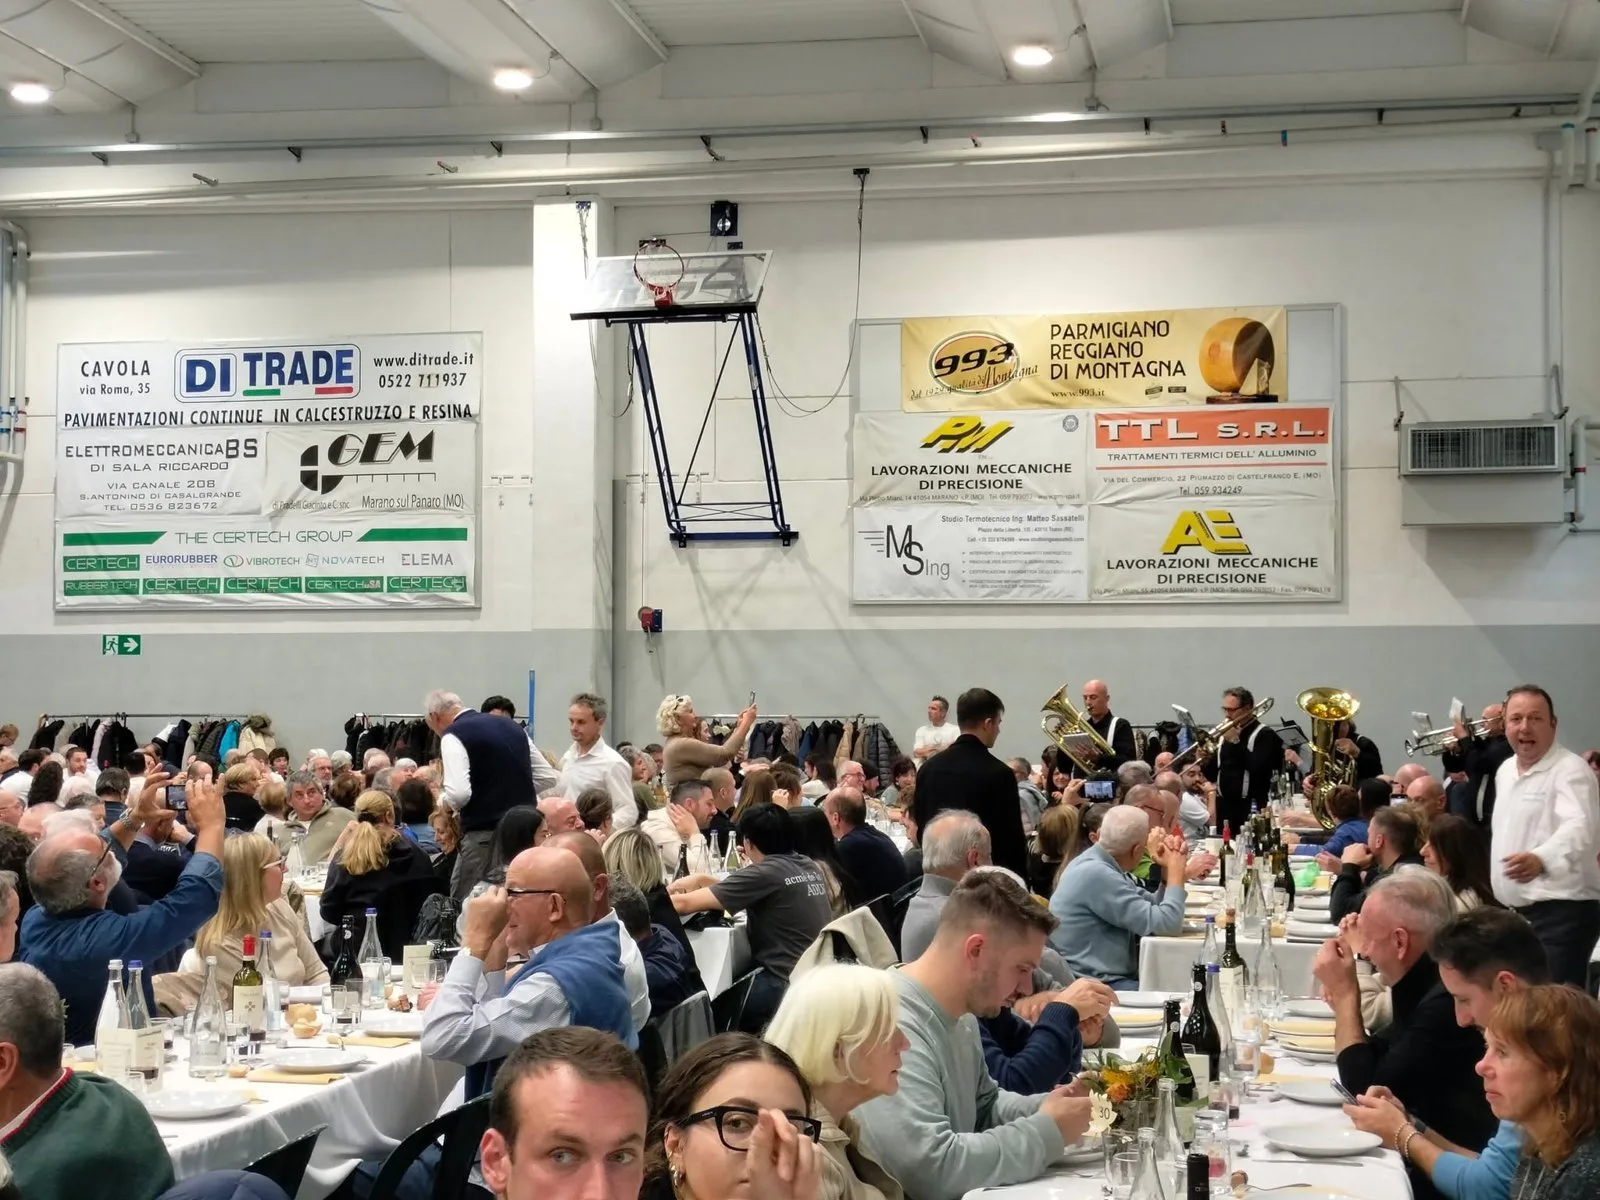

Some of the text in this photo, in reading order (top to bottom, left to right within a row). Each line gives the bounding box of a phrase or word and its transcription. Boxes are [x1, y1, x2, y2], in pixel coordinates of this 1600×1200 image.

[1051, 320, 1169, 340] PARMIGIANO
[1051, 341, 1144, 360] REGGIANO
[373, 351, 474, 367] www.ditrade.it
[934, 342, 1014, 378] 993
[81, 360, 150, 377] CAVOLA
[186, 350, 353, 393] DI TRADE
[1051, 360, 1186, 380] DI MONTAGNA
[379, 372, 466, 388] 0522 711937
[80, 382, 150, 396] via Roma, 35
[1051, 387, 1105, 398] www.993.it
[64, 403, 472, 427] PAVIMENTAZIONI CONTINUE IN CALCESTRUZZO E RESINA
[1099, 418, 1199, 442] TTL
[1217, 420, 1326, 439] S.R.L.
[328, 429, 435, 466] GEM
[1108, 449, 1317, 461] TRATTAMENTI TERMICI DELL' ALLUMINIO
[90, 461, 229, 472] DI SALA RICCARDO
[871, 463, 1072, 476] LAVORAZIONI MECCANICHE
[107, 480, 216, 490] VIA CANALE 208
[919, 479, 1023, 490] DI PRECISIONE
[164, 491, 242, 499] CASALGRANDE
[362, 493, 464, 509] Marano sul Panaro (MO)
[130, 503, 163, 511] 0536
[168, 502, 218, 510] 823672
[942, 515, 964, 523] Studio
[965, 514, 1011, 523] Termotecnico
[1026, 514, 1050, 522] Matteo
[175, 530, 353, 544] THE CERTECH GROUP
[1160, 510, 1252, 555] AE
[66, 557, 138, 570] CERTECH
[146, 554, 218, 564] EURORUBBER
[246, 556, 300, 566] VIBROTECH
[322, 556, 385, 565] NOVATECH
[401, 553, 454, 566] ELEMA
[1107, 557, 1318, 570] LAVORAZIONI MECCANICHE
[926, 559, 950, 580] Ing
[145, 578, 218, 590] CERTECH
[226, 577, 300, 590] CERTECH
[307, 580, 364, 590] CERTECH
[1158, 573, 1266, 584] DI PRECISIONE
[1099, 1107, 1110, 1120] 30
